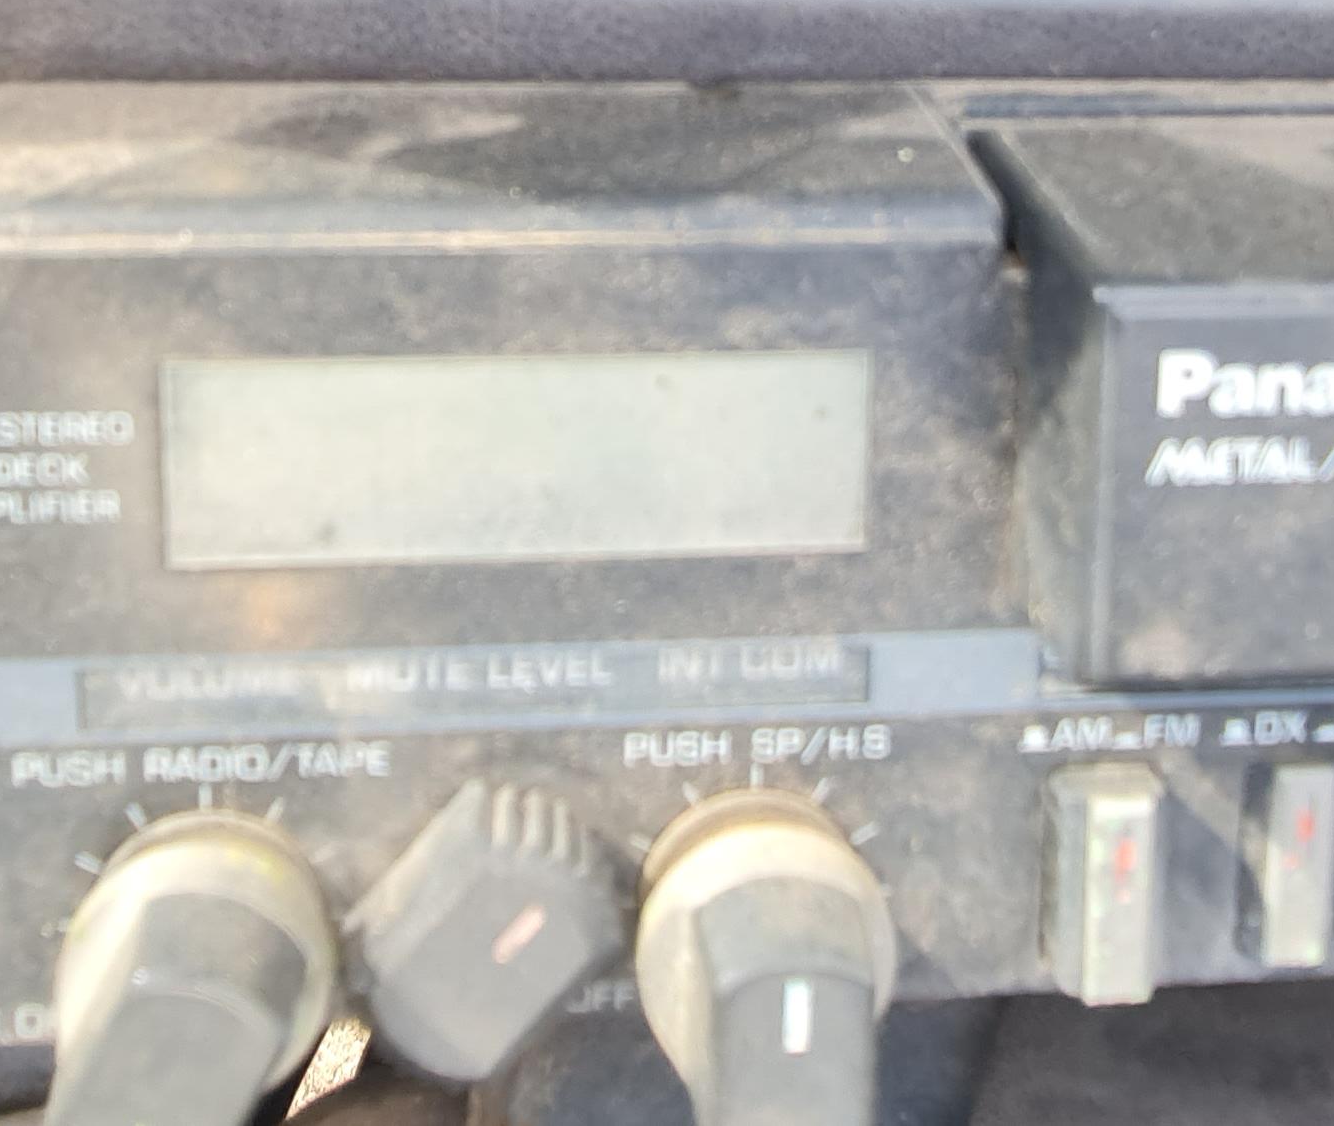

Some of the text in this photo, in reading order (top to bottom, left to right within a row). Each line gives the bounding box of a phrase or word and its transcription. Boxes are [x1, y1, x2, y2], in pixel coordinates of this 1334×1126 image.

[486, 649, 611, 689] LEVEL
[623, 724, 892, 767] PUSH SP/HS
[1050, 713, 1201, 749] AM FM
[1254, 710, 1308, 743] DX
[11, 741, 390, 788] PUSH RADIO/TAPE
